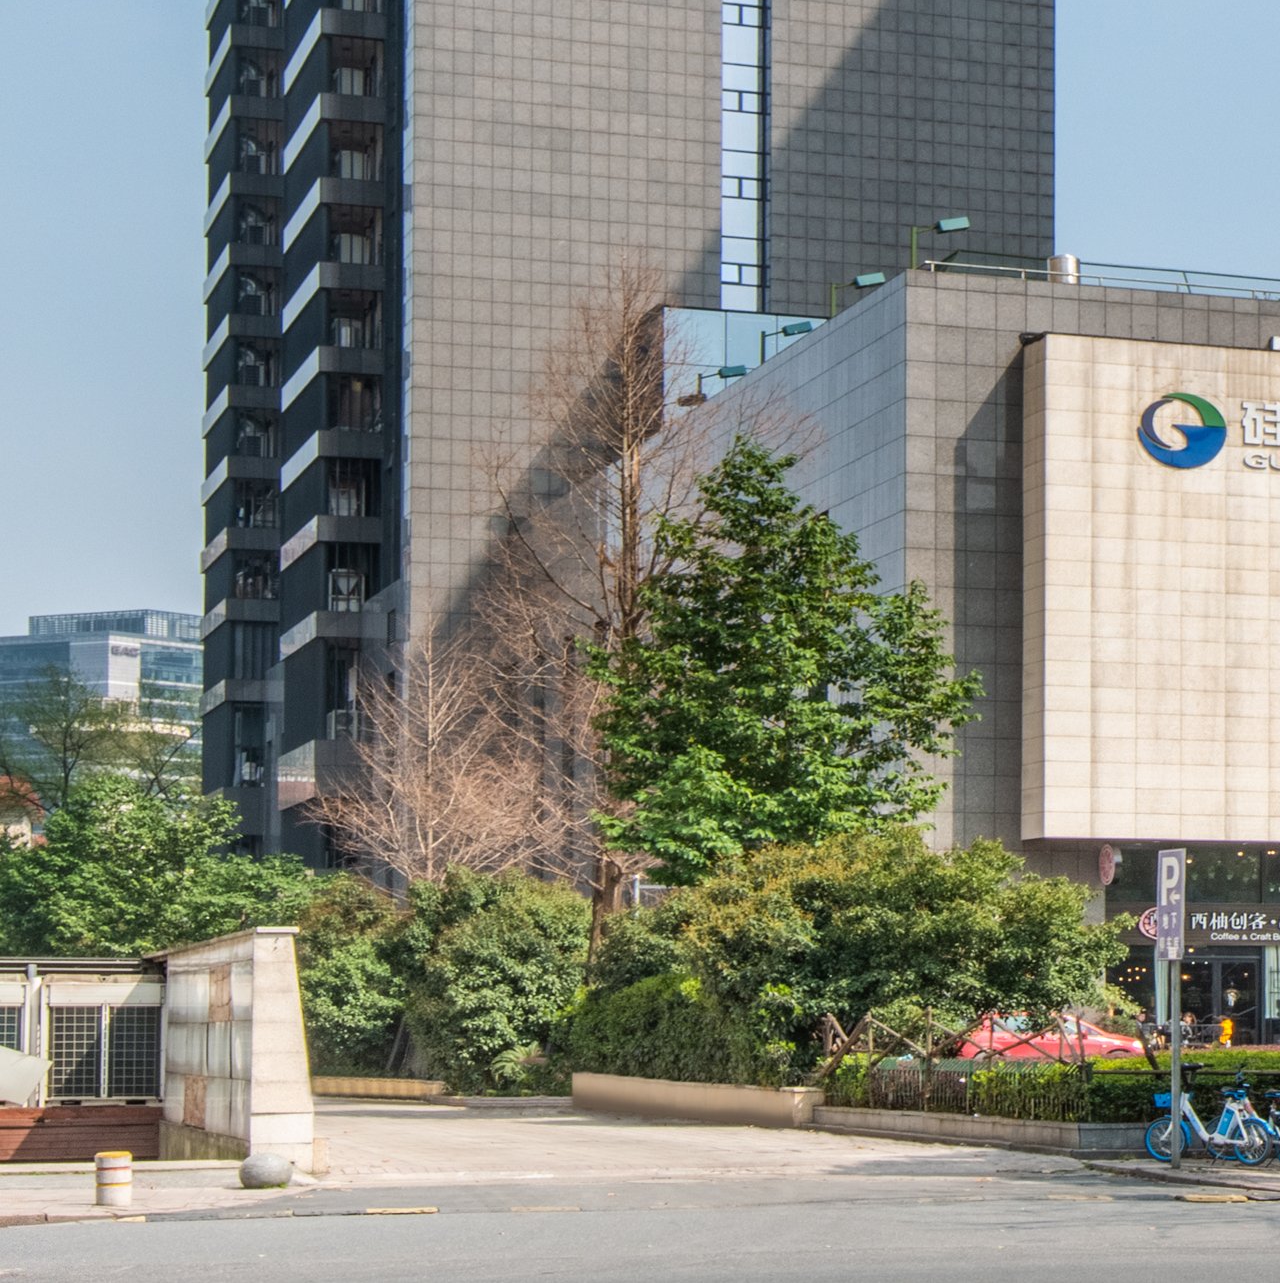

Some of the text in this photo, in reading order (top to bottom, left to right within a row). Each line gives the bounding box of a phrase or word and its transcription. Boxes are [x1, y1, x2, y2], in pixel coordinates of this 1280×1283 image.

[1161, 856, 1179, 906] P
[1210, 932, 1240, 942] Coffee
[1249, 932, 1272, 942] Craft
